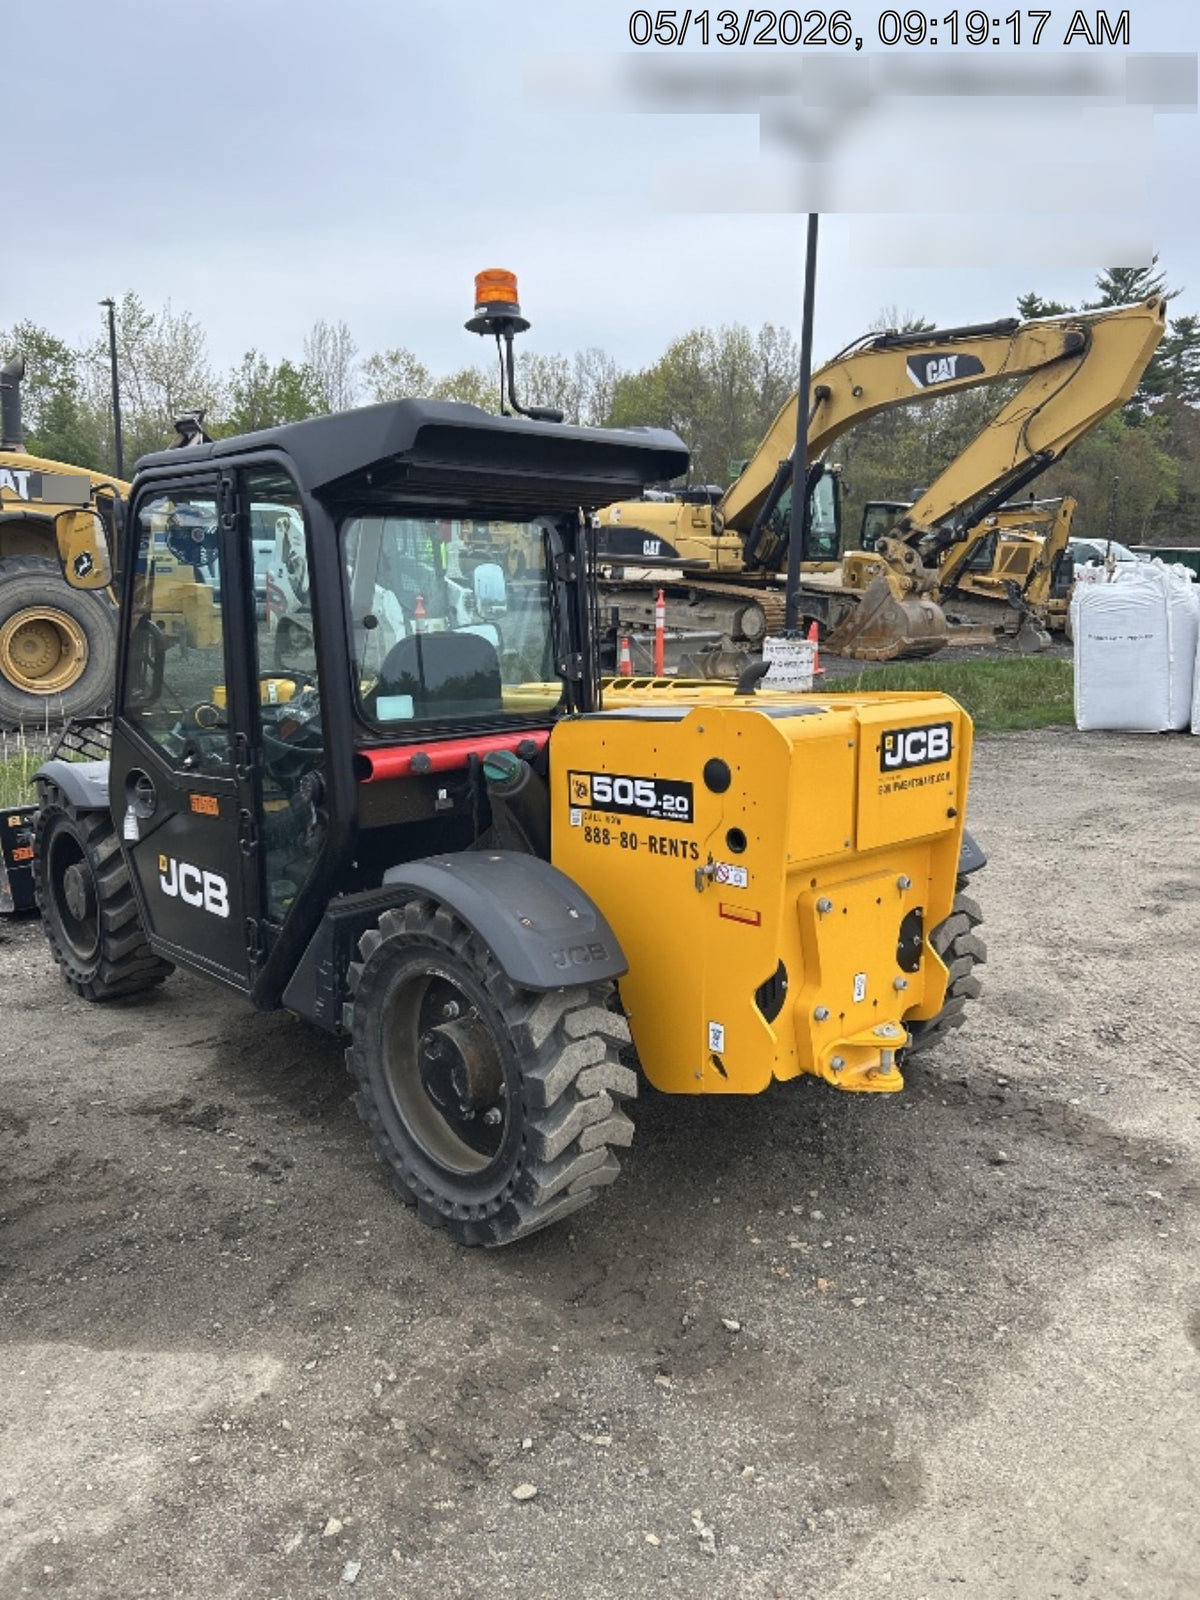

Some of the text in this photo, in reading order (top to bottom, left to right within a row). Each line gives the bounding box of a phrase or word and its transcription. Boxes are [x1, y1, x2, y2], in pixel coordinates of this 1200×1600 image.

[926, 355, 958, 384] CAT
[0, 469, 31, 500] AT
[643, 540, 661, 556] CAT
[885, 727, 949, 766] JCB
[584, 826, 700, 861] 888-80-RENTS
[160, 857, 230, 918] JCB
[552, 943, 609, 970] JCB
